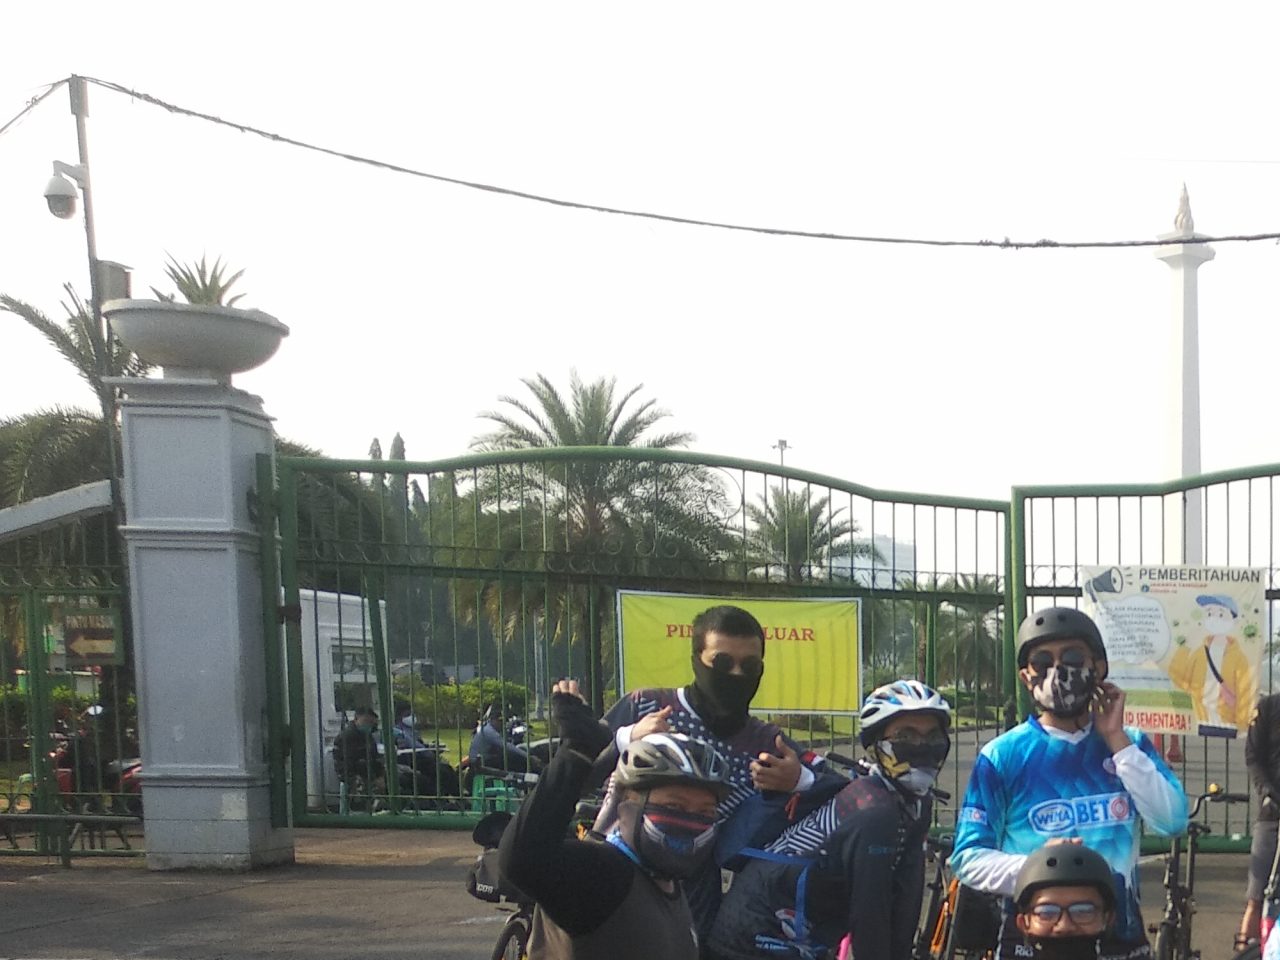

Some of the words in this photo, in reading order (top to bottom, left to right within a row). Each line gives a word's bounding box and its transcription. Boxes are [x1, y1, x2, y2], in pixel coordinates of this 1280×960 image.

[1139, 568, 1260, 583] PEMBERITAHUAN
[763, 626, 815, 641] LUAR
[1137, 712, 1186, 731] SEMENTARA
